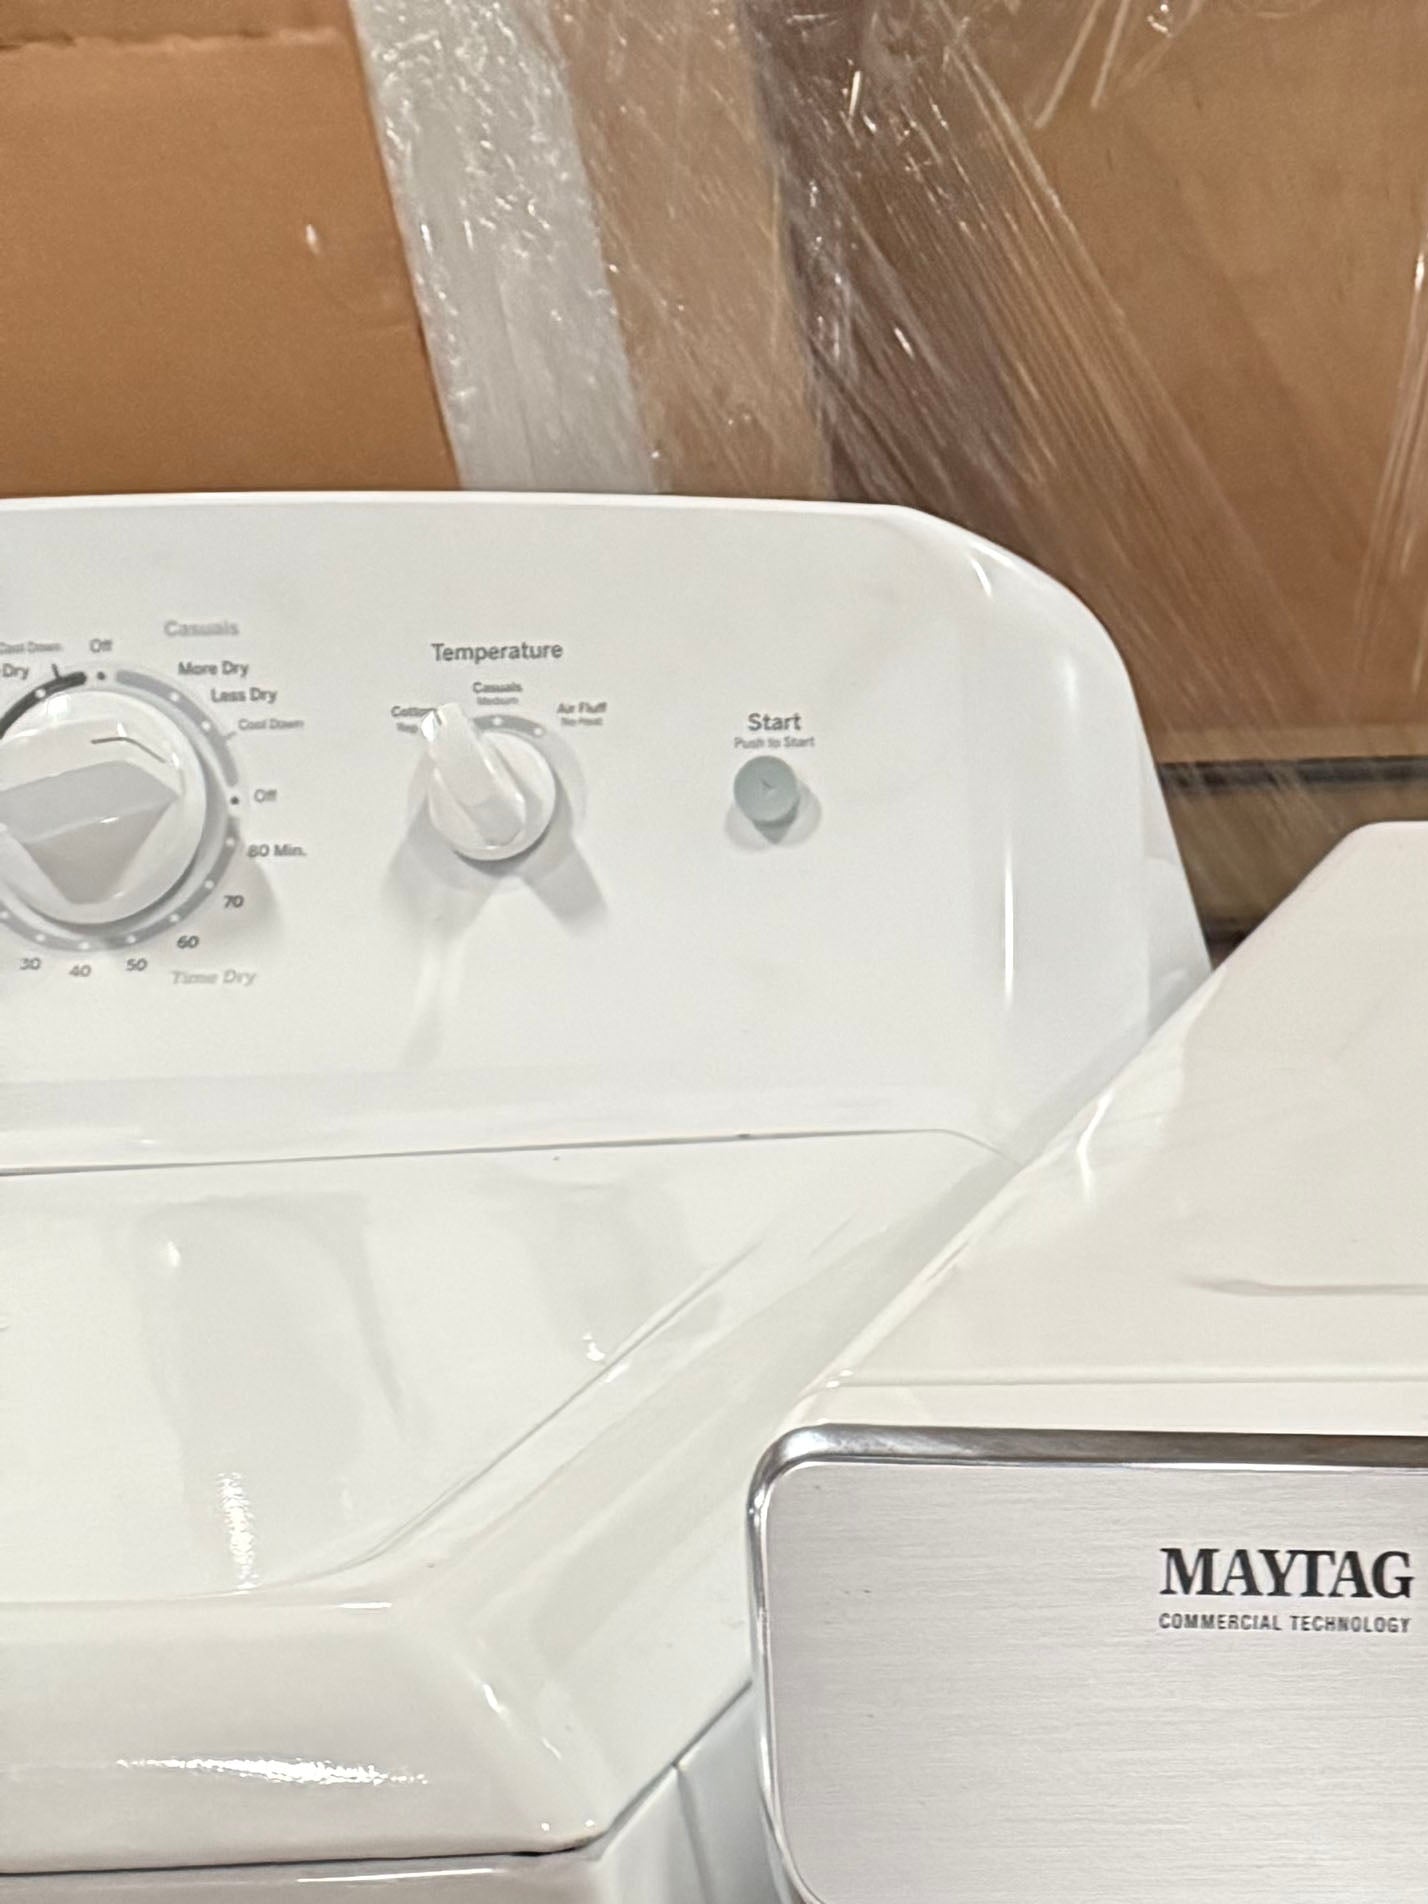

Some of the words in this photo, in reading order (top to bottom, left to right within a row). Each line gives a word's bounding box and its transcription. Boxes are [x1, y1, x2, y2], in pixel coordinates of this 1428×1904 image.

[164, 620, 240, 637] Casuals
[89, 638, 113, 653] Off
[431, 642, 564, 665] Temperature
[2, 662, 30, 681] Dry
[178, 660, 219, 676] More
[221, 660, 250, 677] Dry
[472, 681, 523, 694] Casuals
[211, 688, 247, 703] Less
[249, 687, 278, 704] Dry
[557, 702, 575, 715] Air
[578, 700, 608, 714] Fluff
[238, 718, 267, 731] Cool
[269, 718, 304, 729] Down
[747, 712, 802, 732] Start
[733, 736, 765, 750] Push
[767, 737, 781, 748] to
[783, 735, 815, 748] Start
[253, 788, 278, 803] Off
[246, 844, 271, 858] 80
[273, 844, 307, 857] Min.
[223, 894, 244, 909] 70
[176, 935, 200, 949] 60
[19, 957, 41, 971] 30
[69, 964, 92, 978] 40
[125, 958, 148, 972] 50
[172, 971, 217, 985] Time
[222, 969, 257, 986] Dry
[1159, 1548, 1414, 1599] MAYTAG
[1158, 1612, 1282, 1631] COMMERCIAL
[1290, 1615, 1411, 1633] TECHNOLOGY
